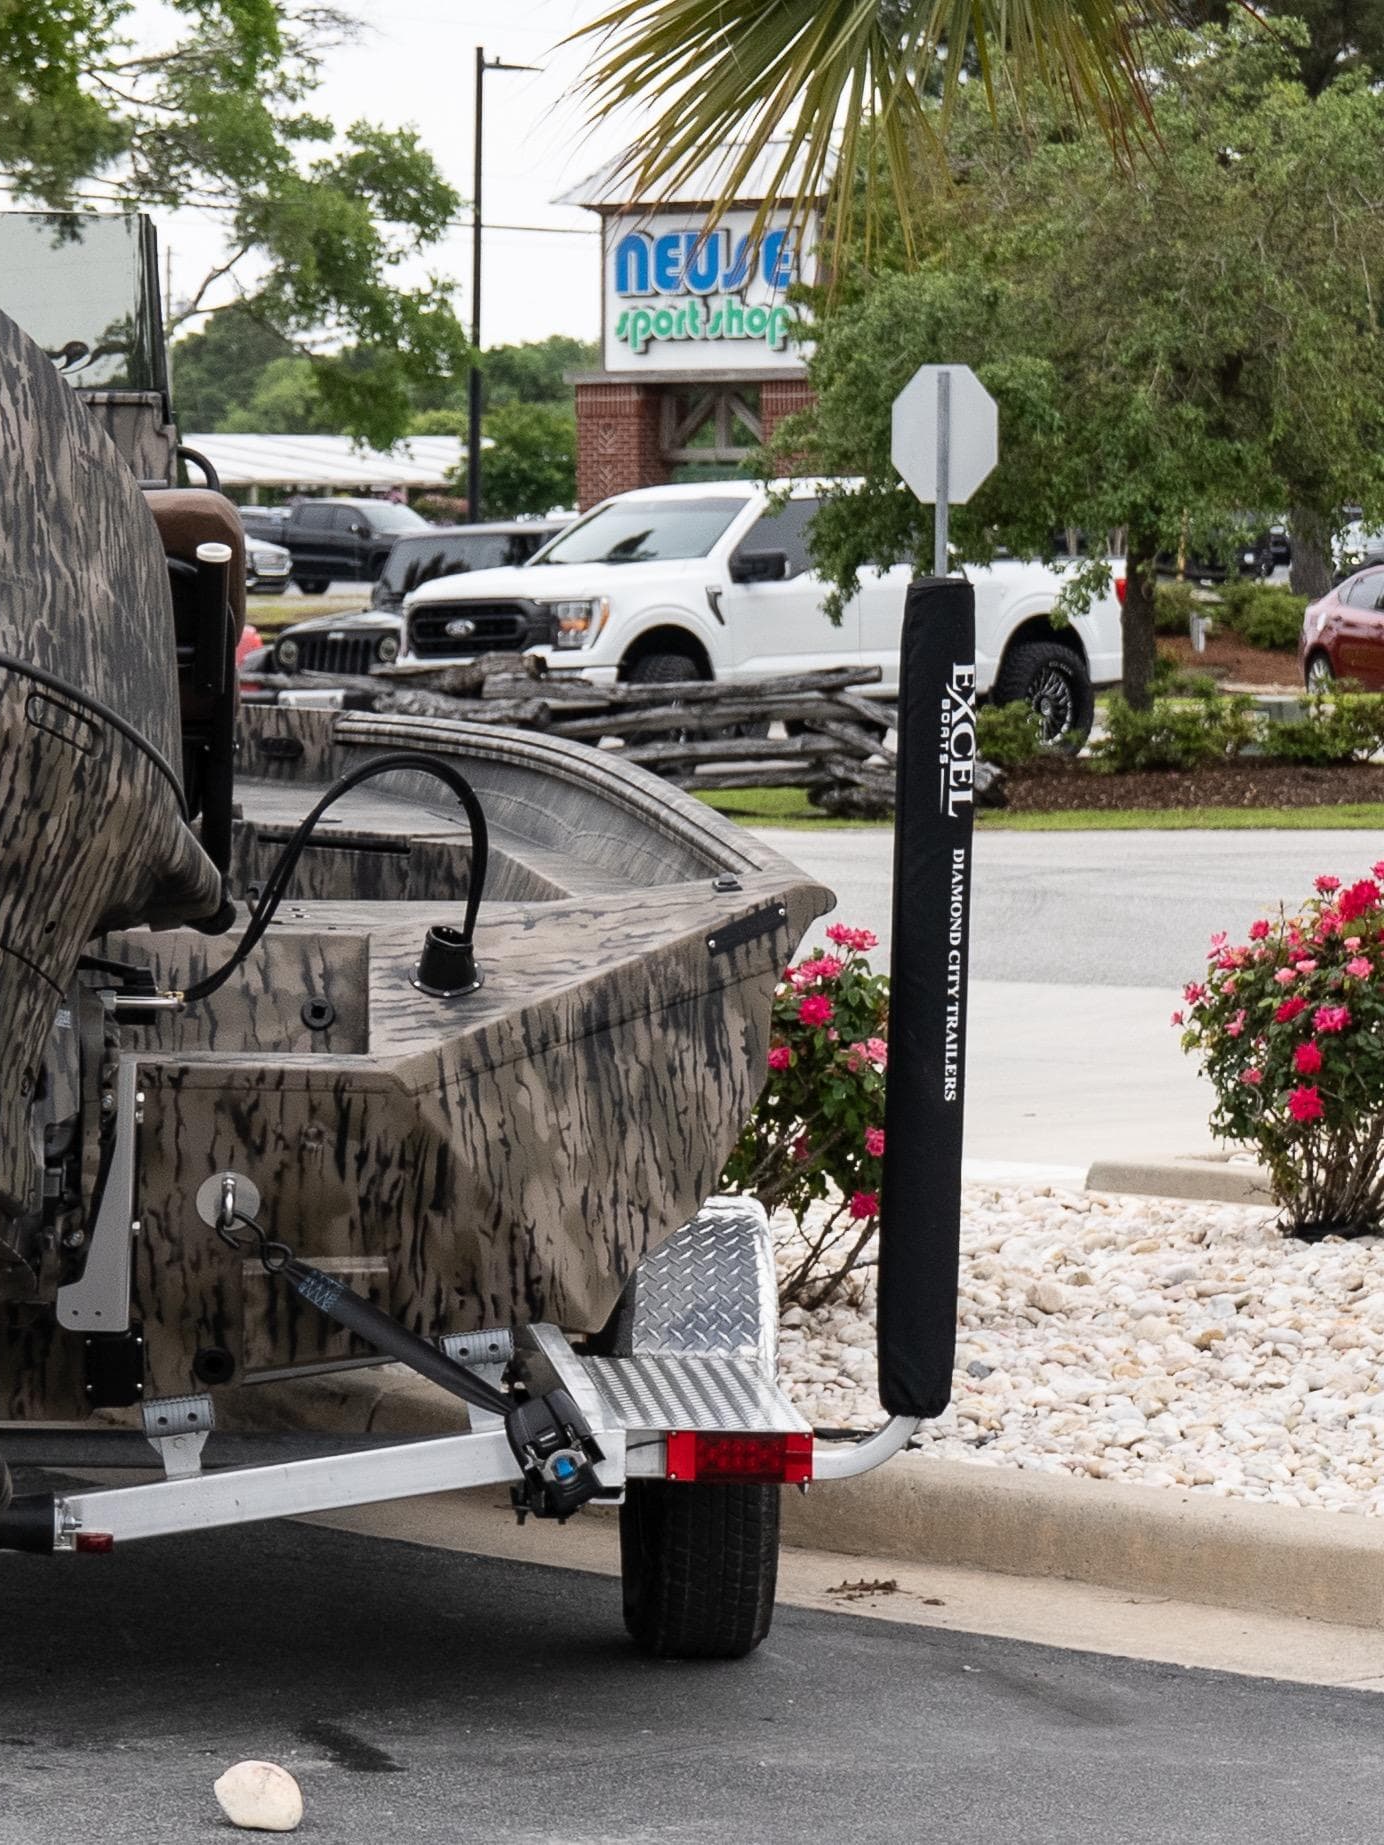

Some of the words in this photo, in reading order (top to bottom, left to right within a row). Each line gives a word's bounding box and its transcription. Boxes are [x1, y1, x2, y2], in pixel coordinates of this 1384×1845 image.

[615, 299, 701, 352] sport
[708, 298, 793, 351] shop
[939, 698, 951, 765] BOATS
[945, 662, 977, 818] EXCEL
[949, 848, 965, 946] DIAMOND
[947, 949, 961, 999] CITY
[944, 1001, 960, 1102] TRAILERS
